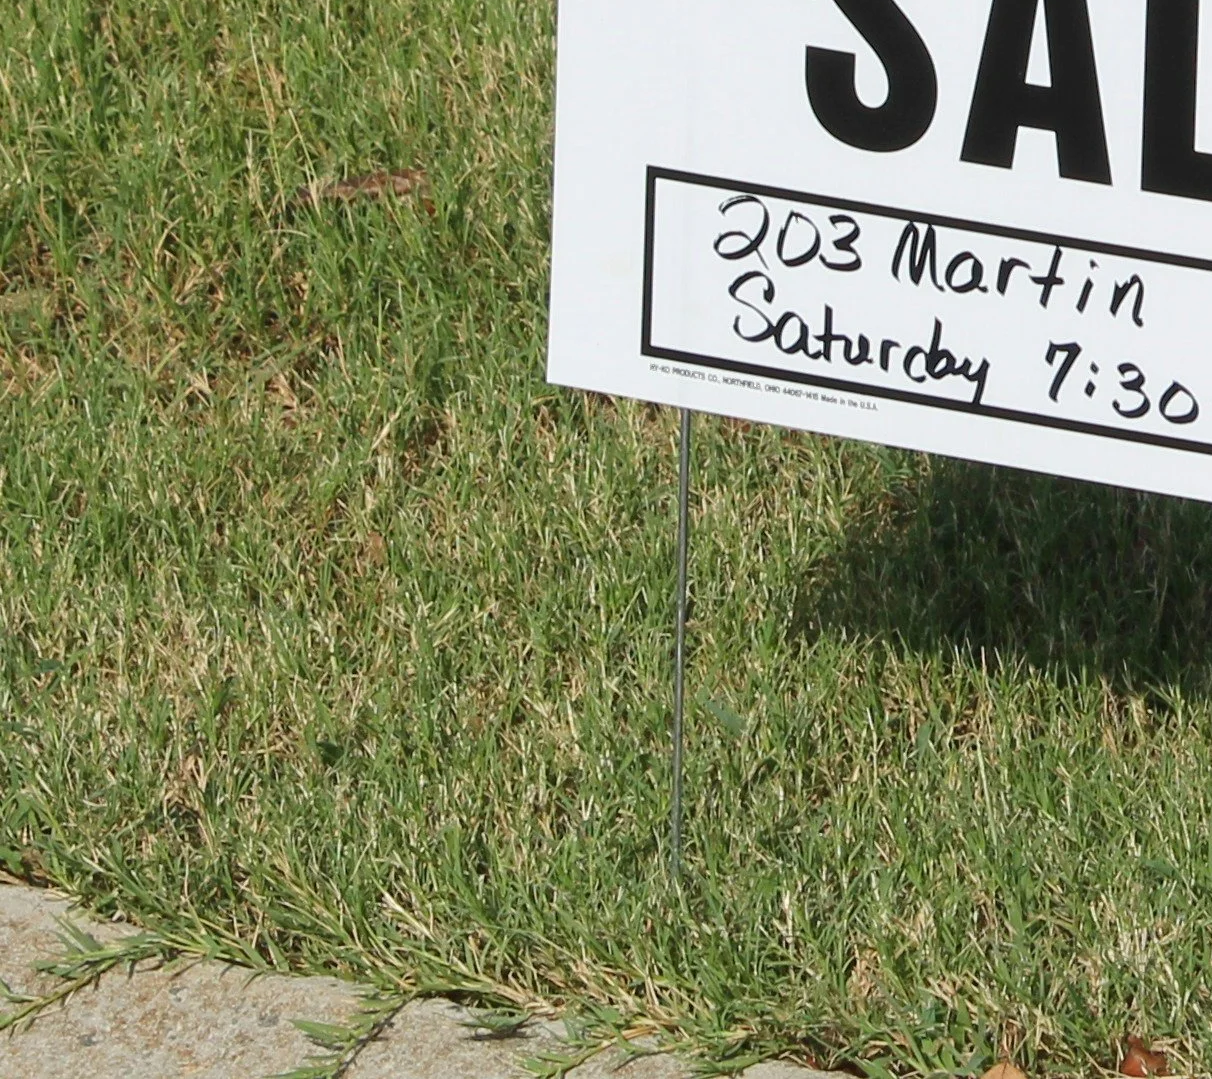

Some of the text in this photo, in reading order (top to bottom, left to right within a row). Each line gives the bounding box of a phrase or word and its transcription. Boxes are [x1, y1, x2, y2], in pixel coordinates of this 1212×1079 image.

[713, 194, 862, 272] 203
[892, 221, 1144, 328] Martin
[672, 366, 705, 381] PRODUCTS
[764, 383, 780, 393] OHIO
[821, 393, 838, 404] Made
[840, 398, 846, 406] in
[848, 400, 858, 408] the
[729, 270, 990, 405] Saturday
